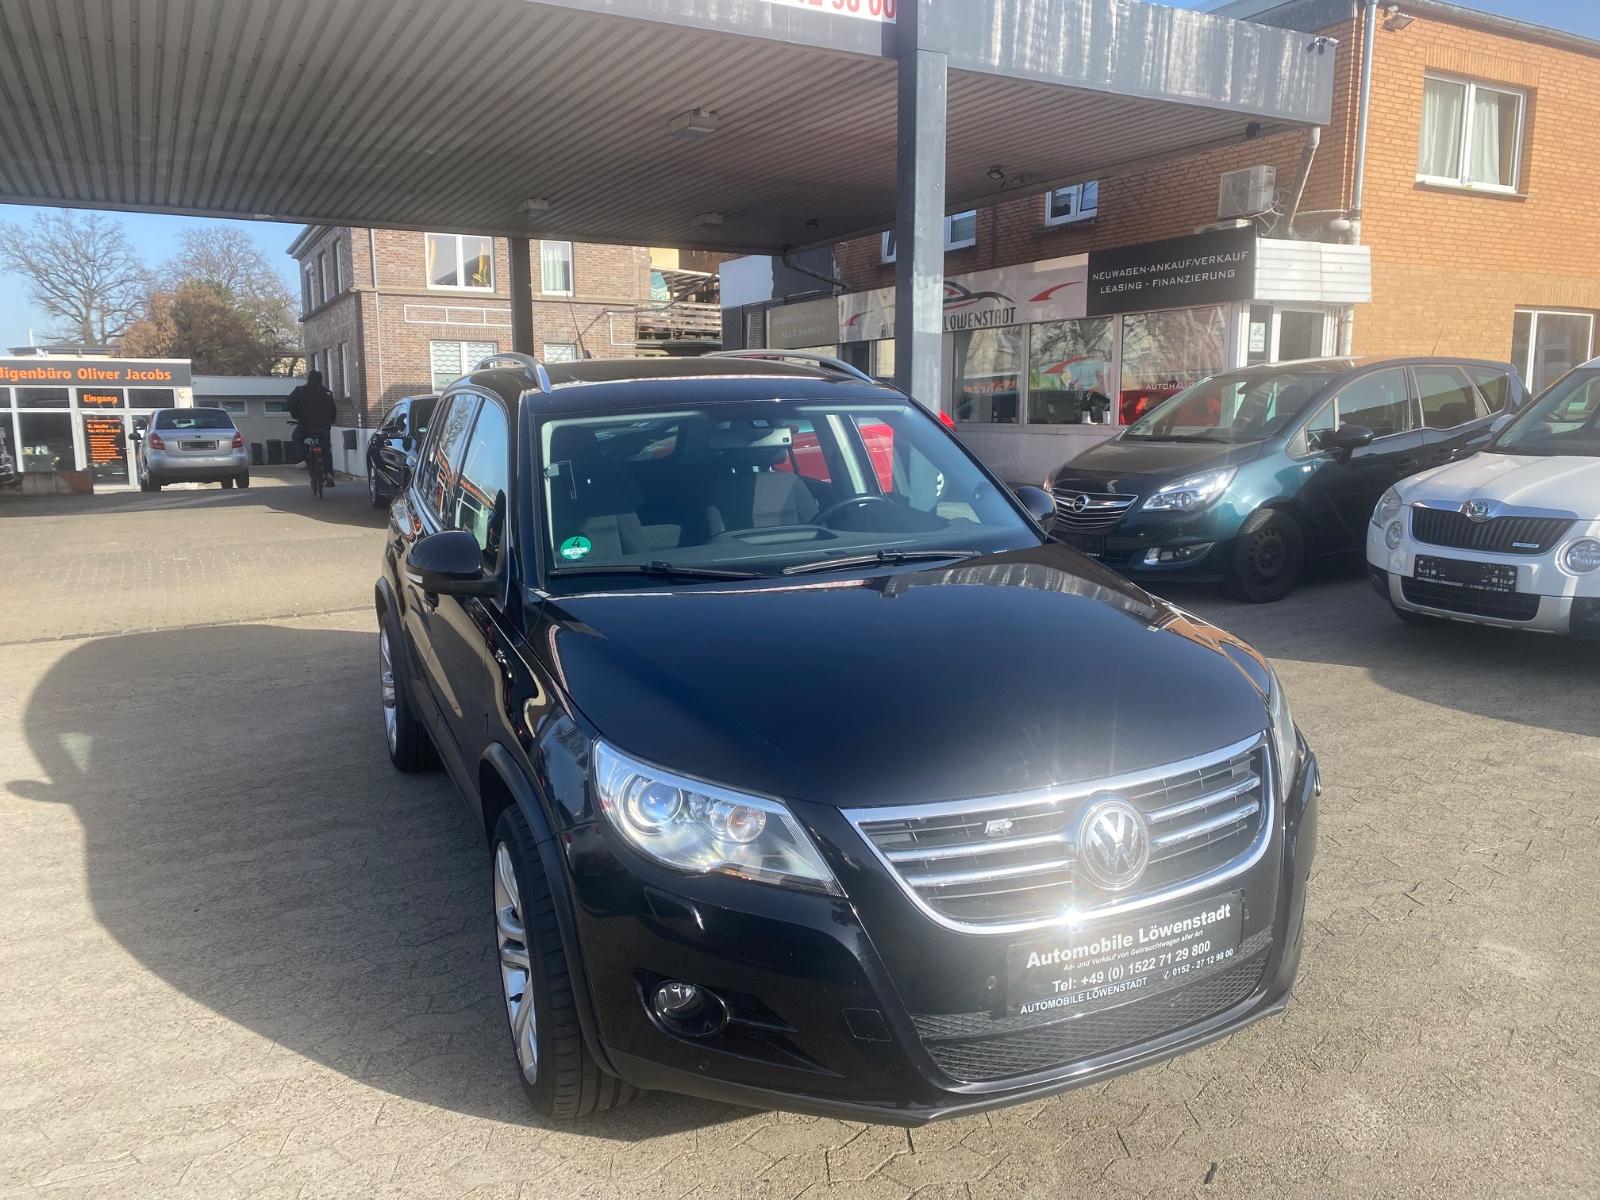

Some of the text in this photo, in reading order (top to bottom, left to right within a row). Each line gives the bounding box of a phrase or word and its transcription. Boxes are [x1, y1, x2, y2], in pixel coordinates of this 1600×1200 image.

[1100, 281, 1142, 294] LEASING
[1152, 269, 1236, 287] FINANZIERUNG
[77, 367, 120, 380] Oliver
[125, 368, 171, 380] Jacobs
[83, 394, 118, 404] Eingang
[1026, 904, 1230, 968] Automobile Löwenstadt
[1077, 960, 1090, 968] und
[1092, 952, 1117, 964] Verkauf
[1181, 933, 1193, 942] aller
[1194, 929, 1204, 938] Art
[1020, 993, 1085, 1014] AUTOMOBILE
[1172, 964, 1190, 976] 0152
[1195, 959, 1205, 969] 27
[1206, 955, 1214, 964] 12
[1225, 948, 1234, 958] 00
[1052, 940, 1211, 993] Tel: +49 (0) 1522 71 29 800
